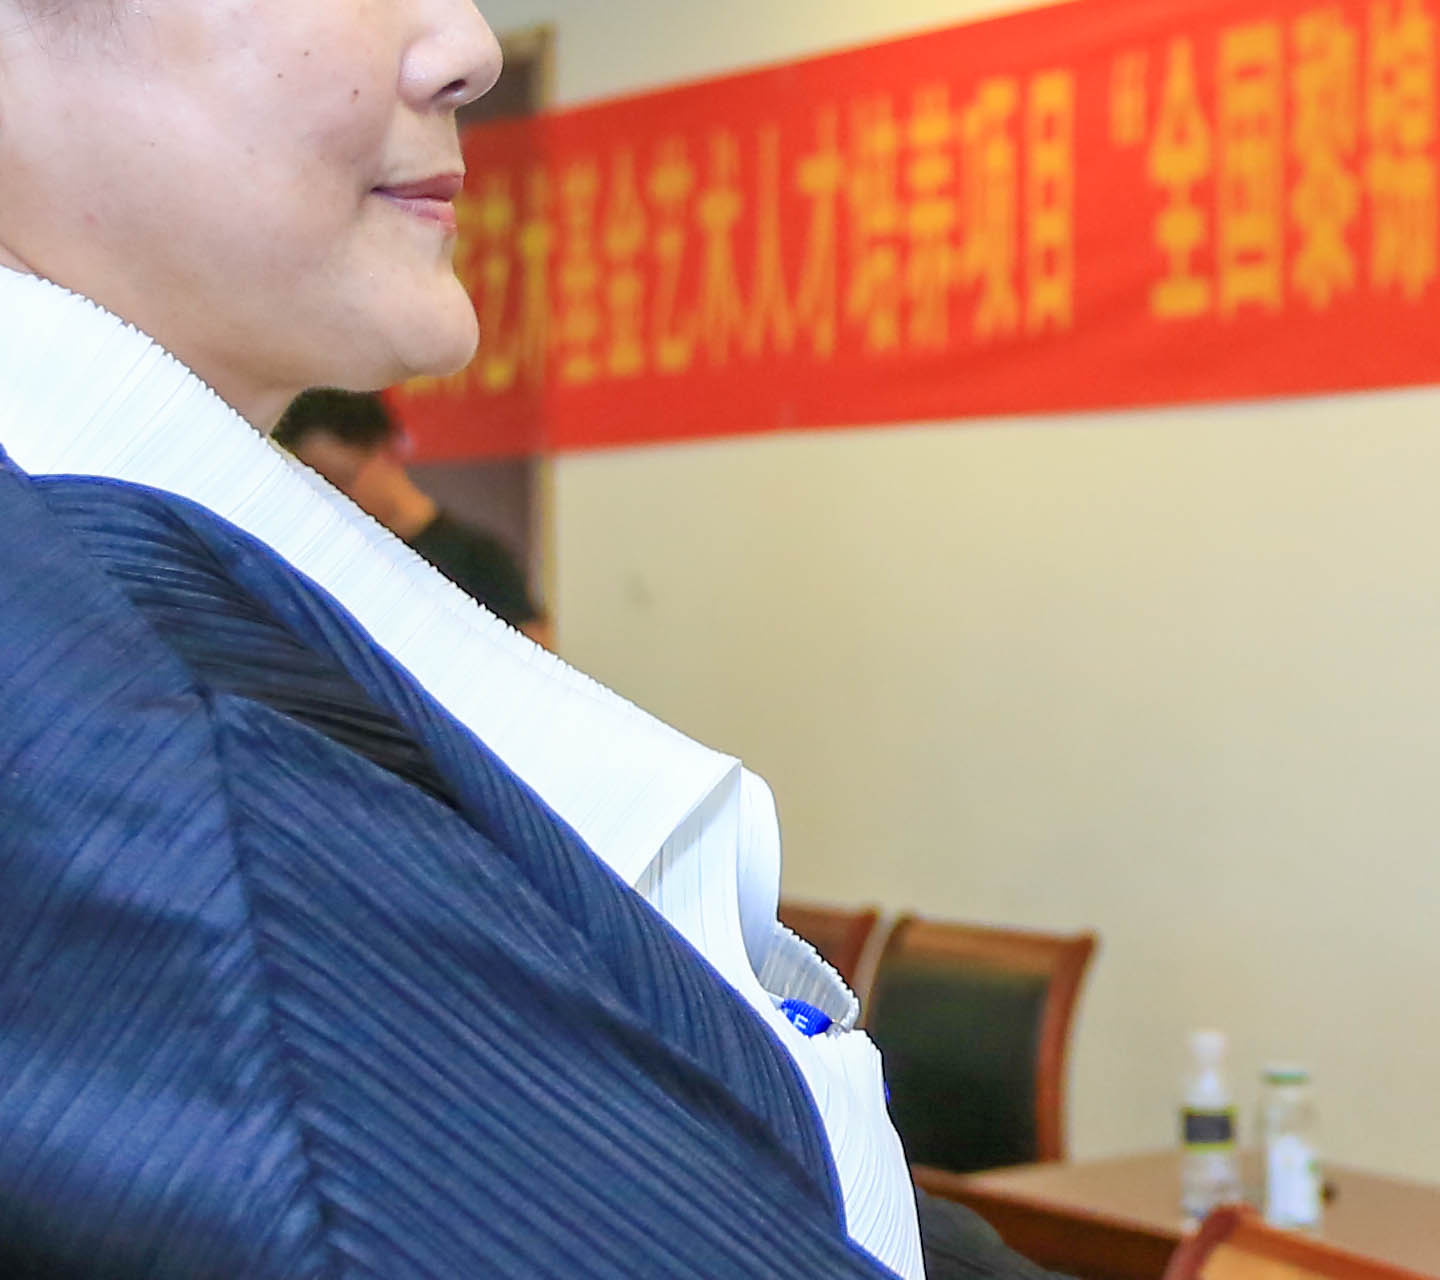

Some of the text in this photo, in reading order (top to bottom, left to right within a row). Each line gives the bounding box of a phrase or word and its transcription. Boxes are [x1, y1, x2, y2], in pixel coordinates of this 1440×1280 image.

[402, 70, 1072, 393] 艺术基金艺术人才培养项目
